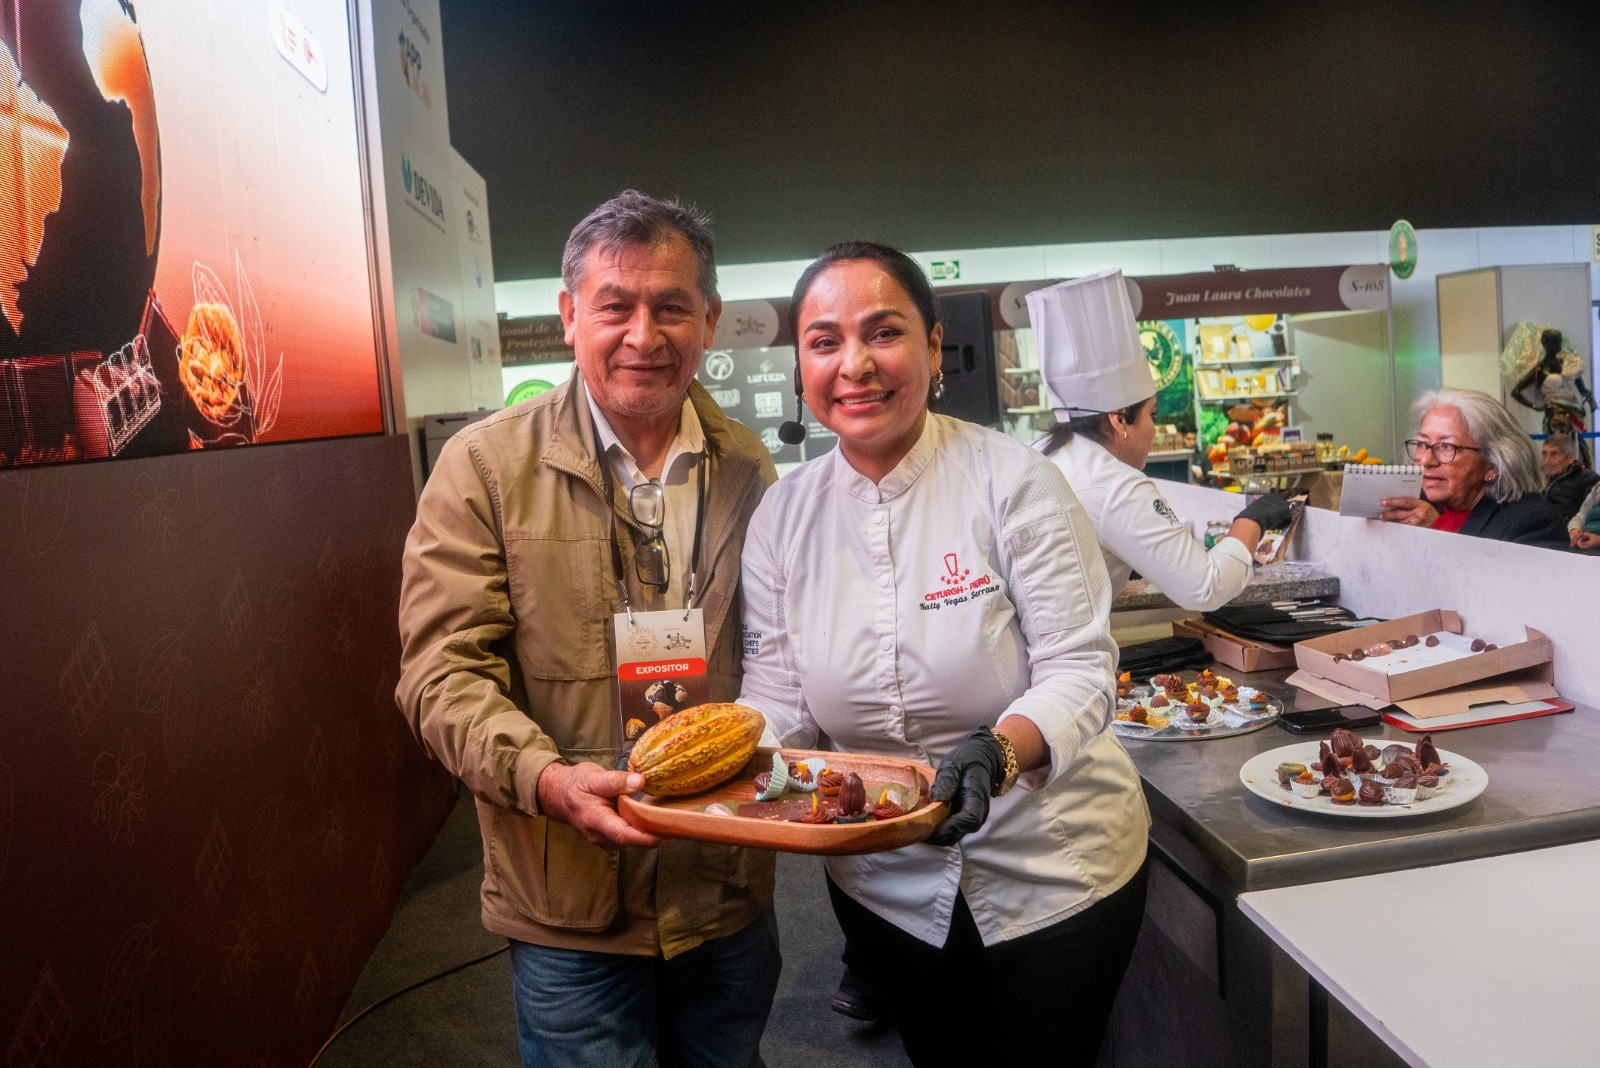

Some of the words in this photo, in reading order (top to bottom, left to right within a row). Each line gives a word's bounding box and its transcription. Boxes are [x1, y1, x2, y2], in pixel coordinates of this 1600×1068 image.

[413, 170, 445, 222] DEVIDA
[931, 265, 956, 276] SALIDA
[1166, 292, 1200, 306] Juan
[1203, 290, 1242, 301] Laura
[1245, 286, 1312, 300] Chocolates
[1351, 280, 1386, 292] S-108
[925, 586, 964, 601] CETURGH
[969, 574, 991, 590] PERÚ
[944, 595, 968, 606] Vegas
[970, 584, 1000, 599] Serrano
[635, 663, 689, 675] EXPOSITOR
